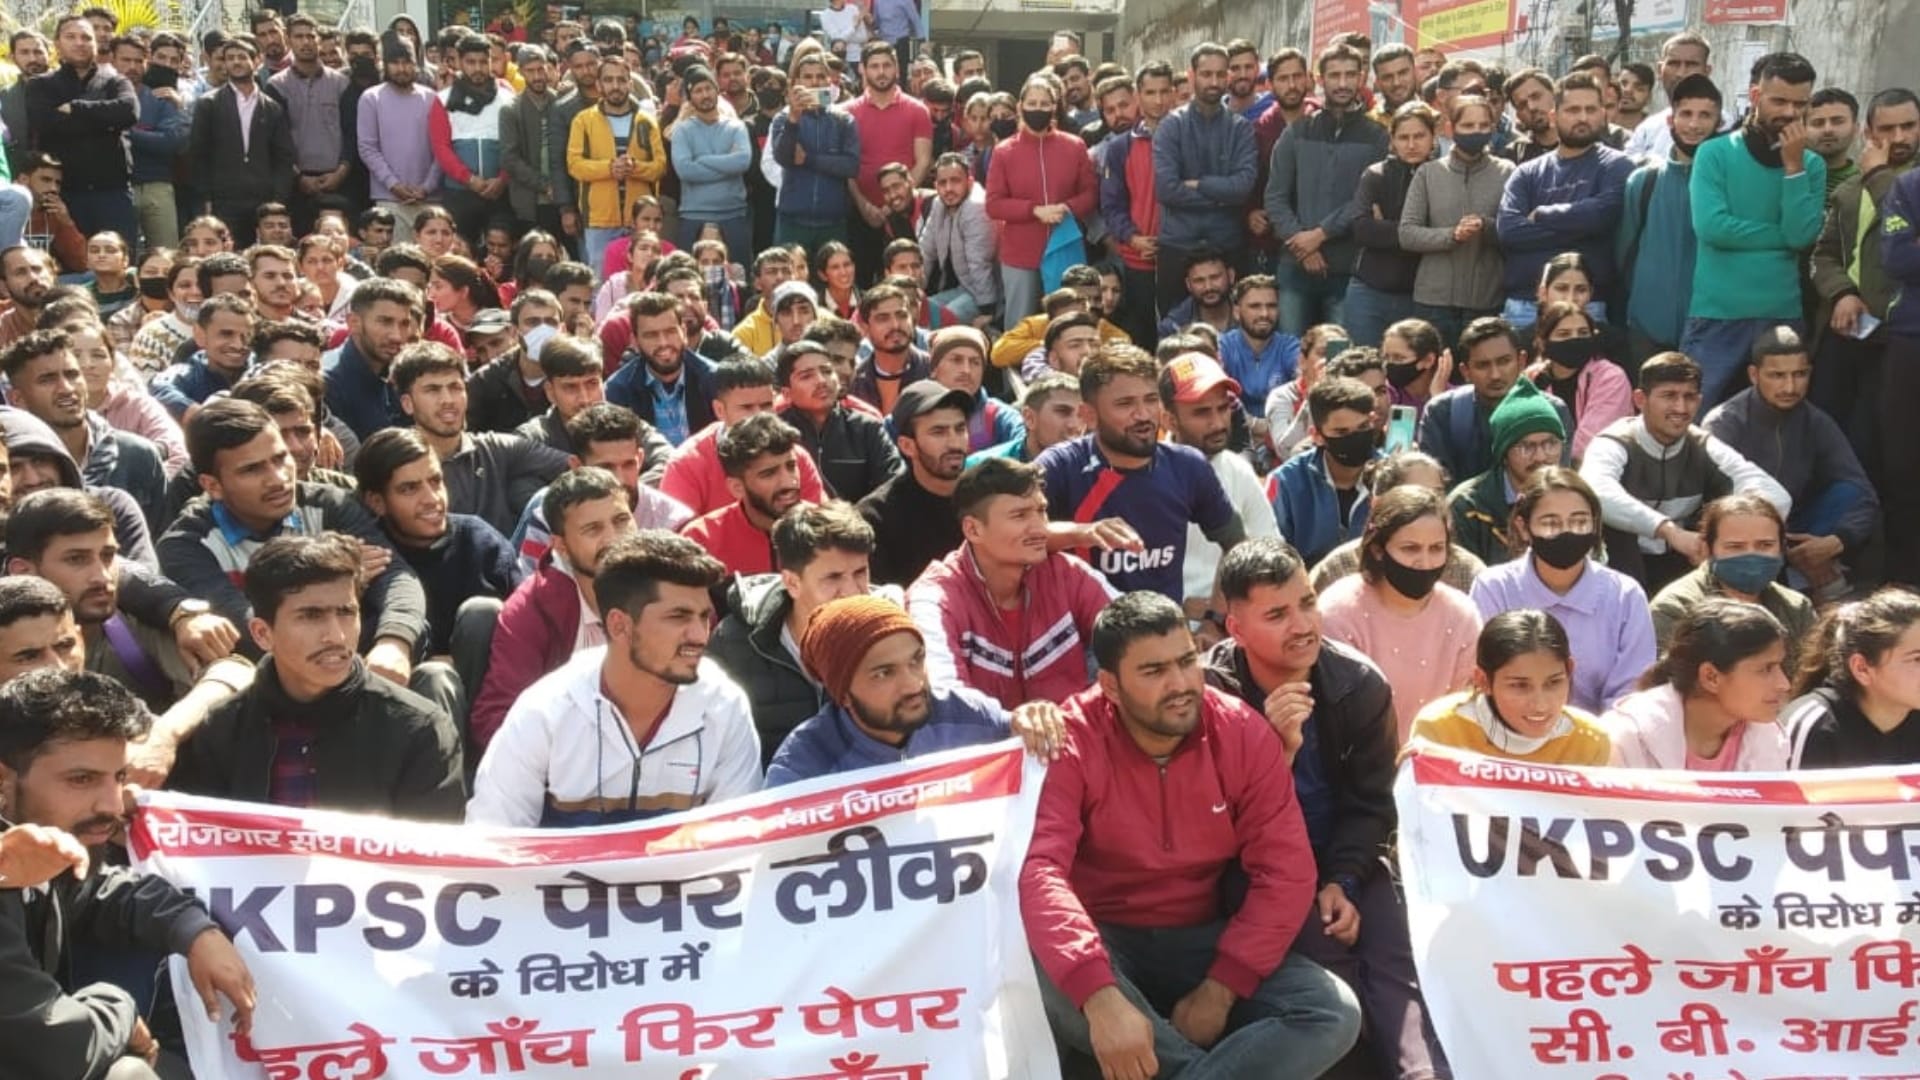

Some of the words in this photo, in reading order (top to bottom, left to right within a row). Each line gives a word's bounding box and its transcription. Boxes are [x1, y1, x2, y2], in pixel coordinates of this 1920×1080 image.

[1100, 545, 1175, 574] UCMS
[1451, 813, 1753, 882] UKPSC
[1781, 811, 1920, 882] पेप
[180, 880, 501, 955] KPSC
[536, 870, 752, 939] पेपर
[770, 825, 995, 925] लीक
[1718, 893, 1762, 930] के
[1773, 892, 1884, 930] विरोध
[448, 958, 503, 998] के
[516, 950, 649, 995] विरोध
[660, 941, 711, 981] में
[1493, 944, 1662, 1001] पहले
[1675, 945, 1832, 995] जाँच
[410, 1016, 596, 1075] जाँच
[617, 1002, 783, 1062] फिर
[798, 986, 967, 1038] पेपर
[1529, 1008, 1634, 1063] सी.
[1656, 1002, 1755, 1056] बी.
[1779, 1000, 1920, 1057] आई
